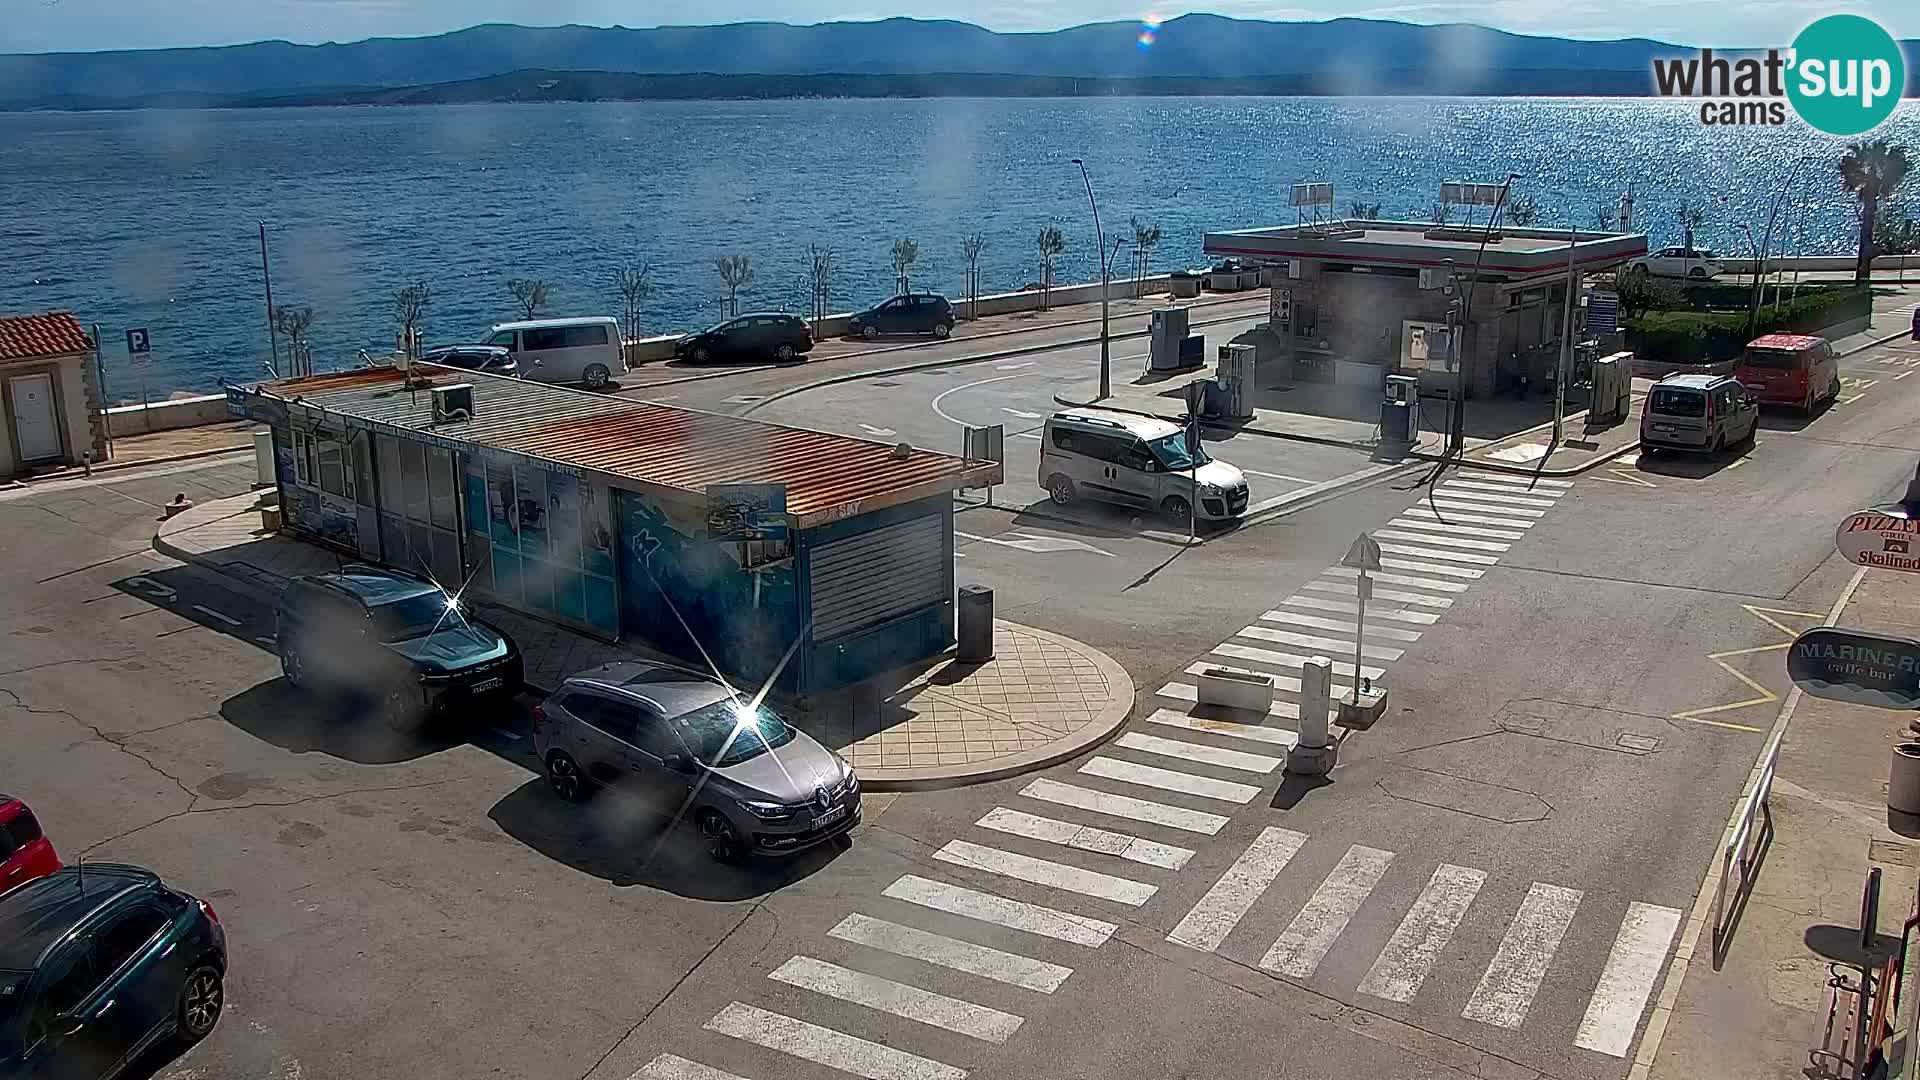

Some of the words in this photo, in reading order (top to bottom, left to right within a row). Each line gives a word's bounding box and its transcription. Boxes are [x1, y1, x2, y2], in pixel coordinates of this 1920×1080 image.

[131, 332, 144, 350] P
[1847, 516, 1920, 534] PIZZE
[1880, 531, 1913, 542] GRILL
[1869, 666, 1896, 680] bar
